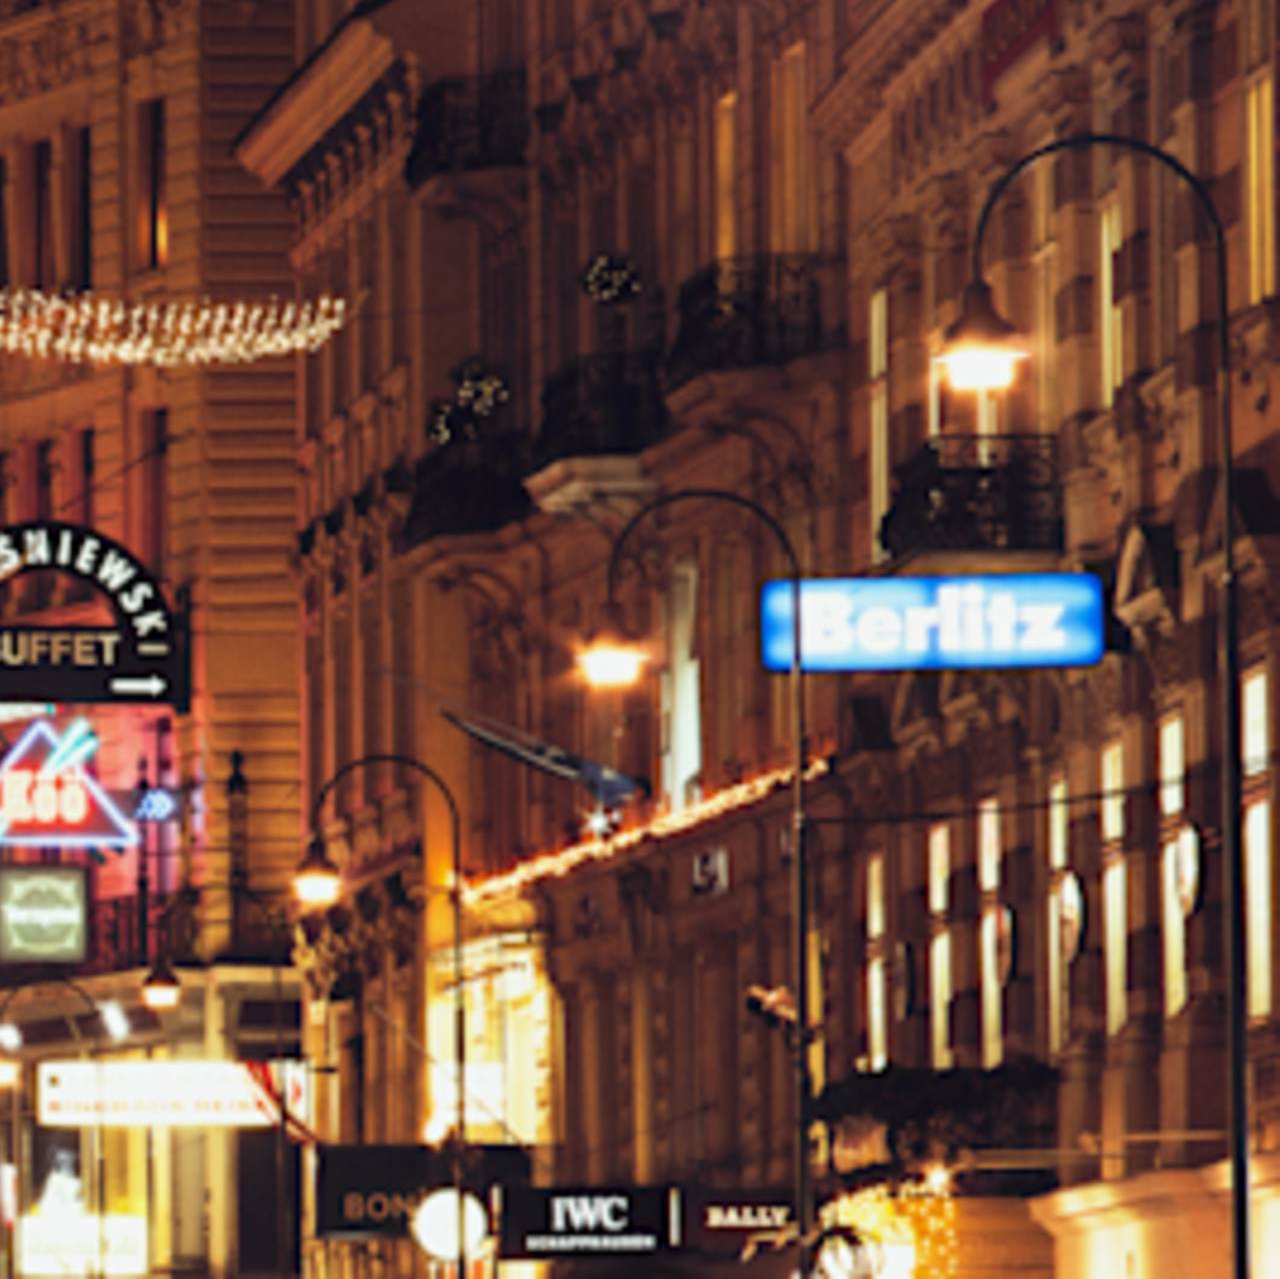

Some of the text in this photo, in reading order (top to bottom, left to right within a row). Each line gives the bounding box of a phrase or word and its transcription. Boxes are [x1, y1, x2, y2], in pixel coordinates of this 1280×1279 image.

[801, 583, 1067, 654] Berlitz
[552, 1195, 629, 1233] IWC
[706, 1205, 790, 1228] BALLY
